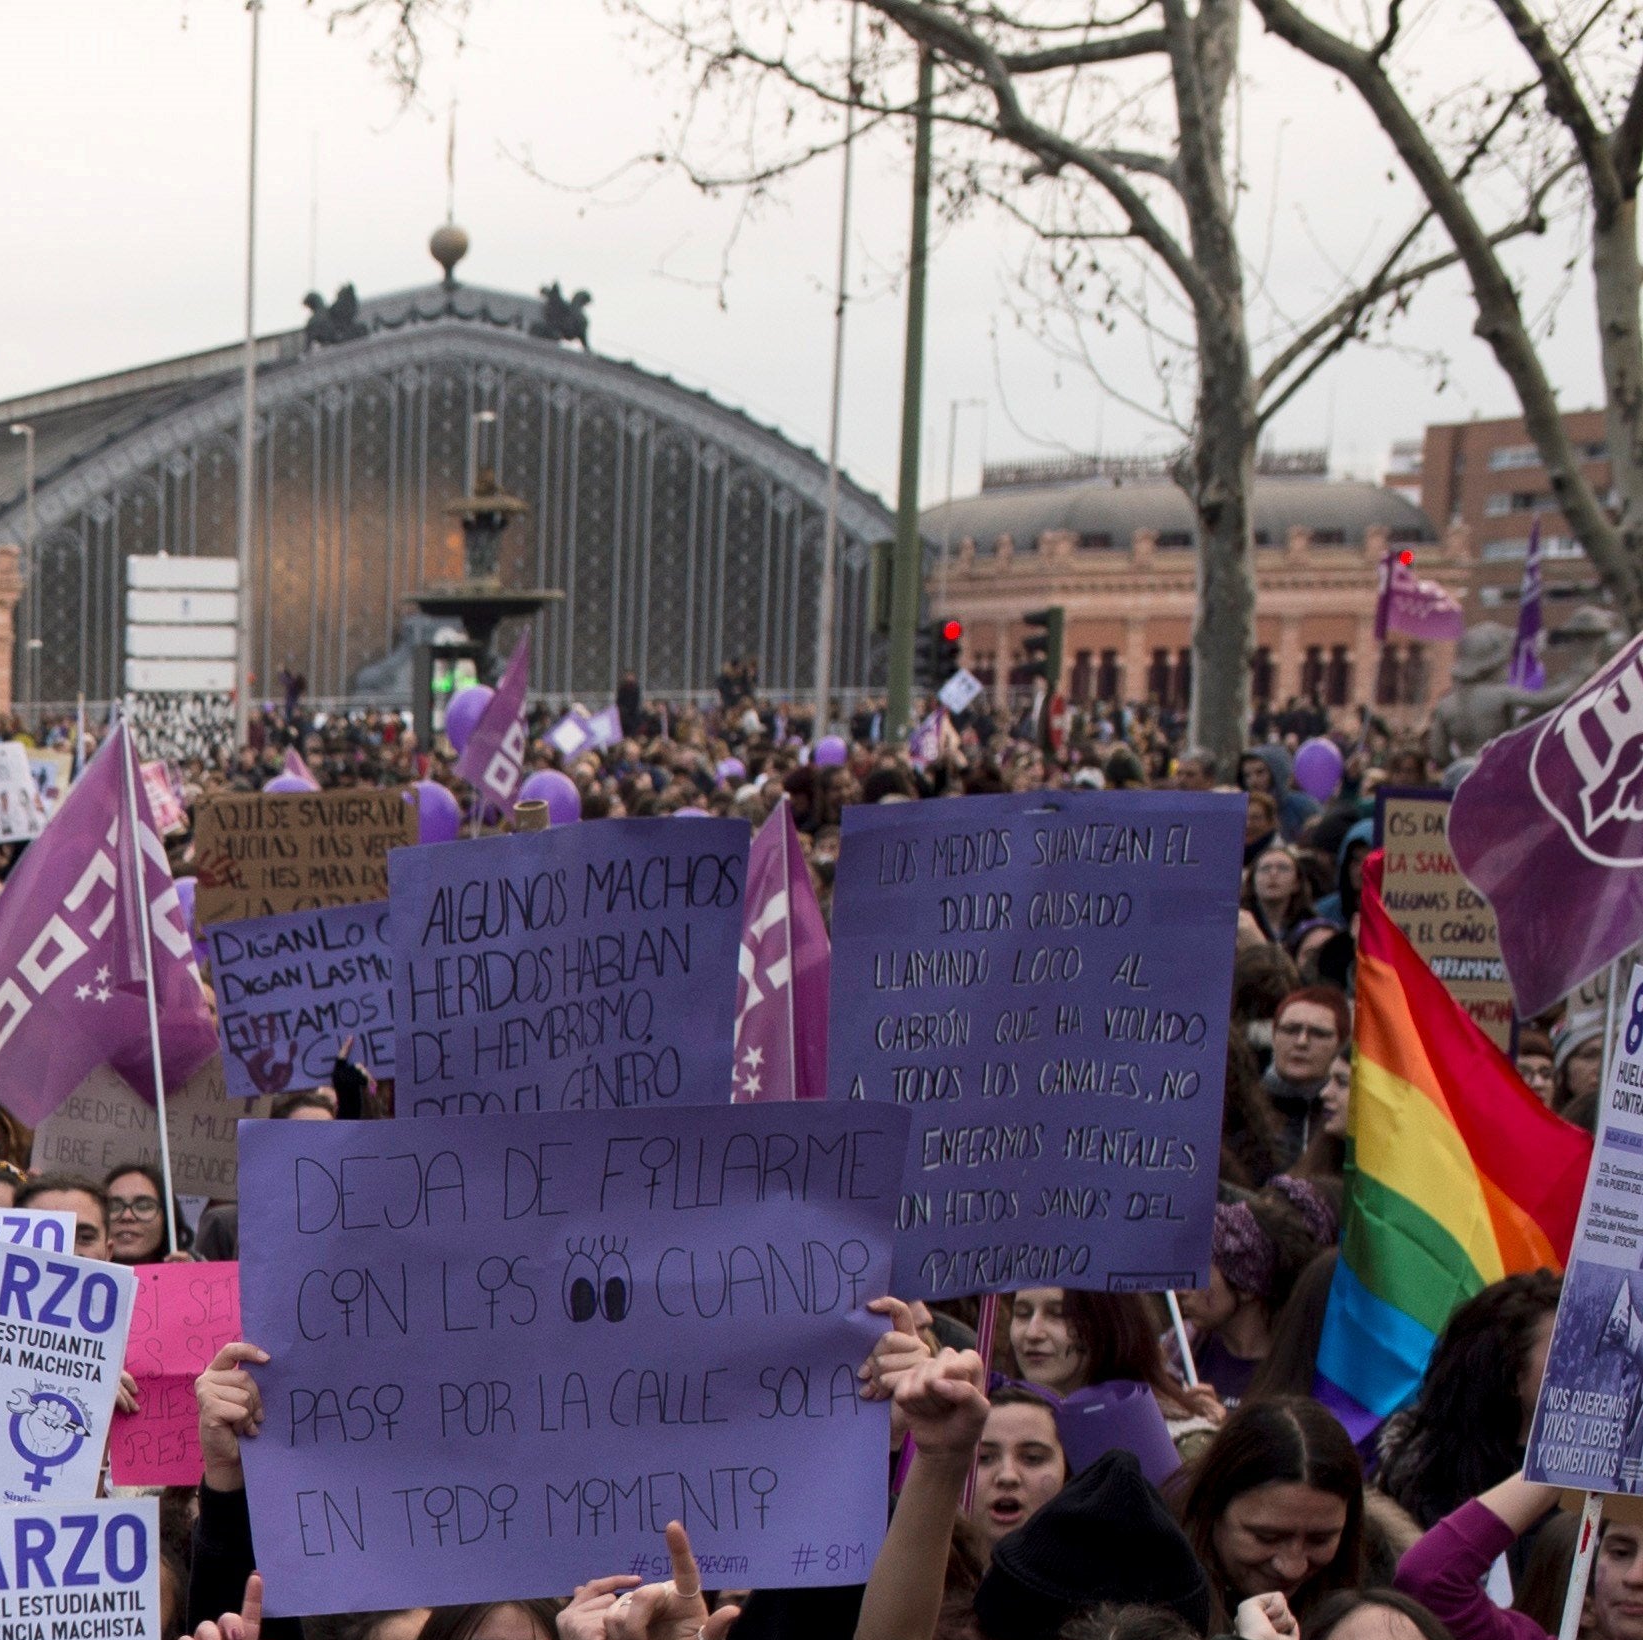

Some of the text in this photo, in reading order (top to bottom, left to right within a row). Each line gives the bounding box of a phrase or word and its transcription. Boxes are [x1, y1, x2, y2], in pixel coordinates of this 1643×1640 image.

[877, 823, 1200, 886] LOS MEDIOS SUAVIZAN EL
[421, 854, 742, 947] ALGUNOS MACHOS
[939, 892, 1133, 934] DOLOR CAUSADO
[220, 968, 302, 1004] DIGAN
[408, 924, 690, 1021] HERIDOS HABLAN
[874, 946, 1150, 991] LLAMANDO LOCO AL
[412, 989, 654, 1085] DE HEMBRISMO,
[876, 1006, 1207, 1052] CABRÓN QUE HA VIOLADO,
[561, 1046, 681, 1110] GÉNERO
[891, 1066, 962, 1102] TODOS
[981, 1060, 1020, 1099] LOS
[1160, 1070, 1200, 1103] NO
[923, 1123, 1198, 1175] ENFERMOS MENTALES,
[295, 1130, 884, 1234] DEJA DE FOLLARME
[894, 1187, 1187, 1230] ON HIJOS SANOS DEL
[297, 1239, 870, 1342] CON LOS CUANDO
[919, 1243, 1091, 1293] PATRIARCADO
[290, 1363, 859, 1445] PASO POR LA CALLE SOLA
[296, 1466, 778, 1557] EN TODO MOMENTO
[790, 1542, 866, 1576] #8M
